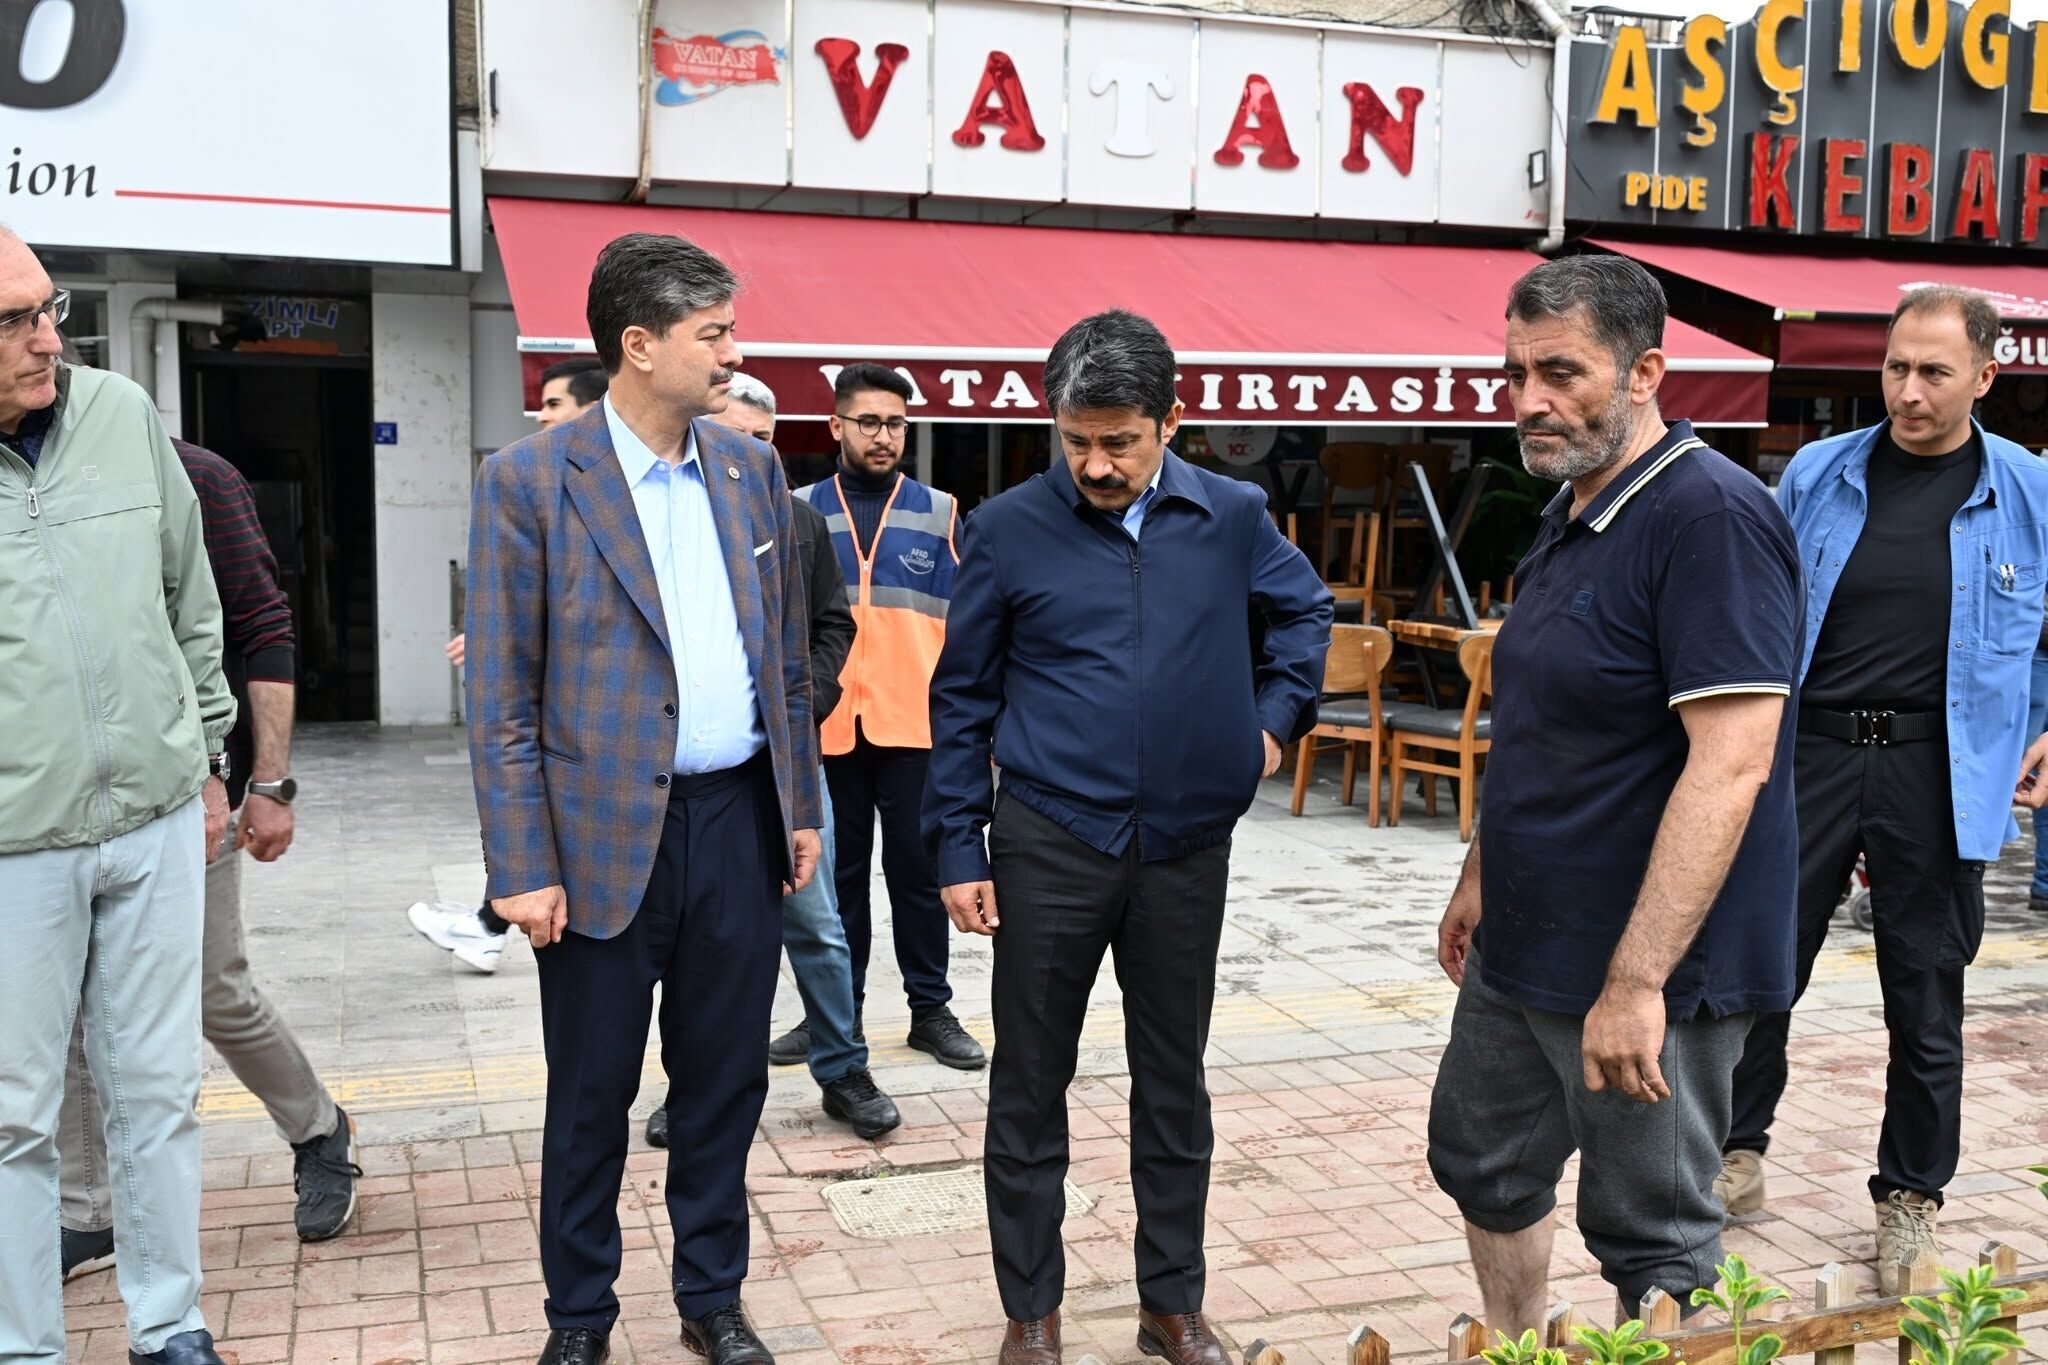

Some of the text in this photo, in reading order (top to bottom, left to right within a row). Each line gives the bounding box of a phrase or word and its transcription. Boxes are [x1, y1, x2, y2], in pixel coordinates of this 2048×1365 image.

[671, 40, 758, 70] VATAN
[814, 37, 1424, 177] VATAN
[7, 146, 99, 198] ion
[1172, 366, 1507, 413] IRTASİY
